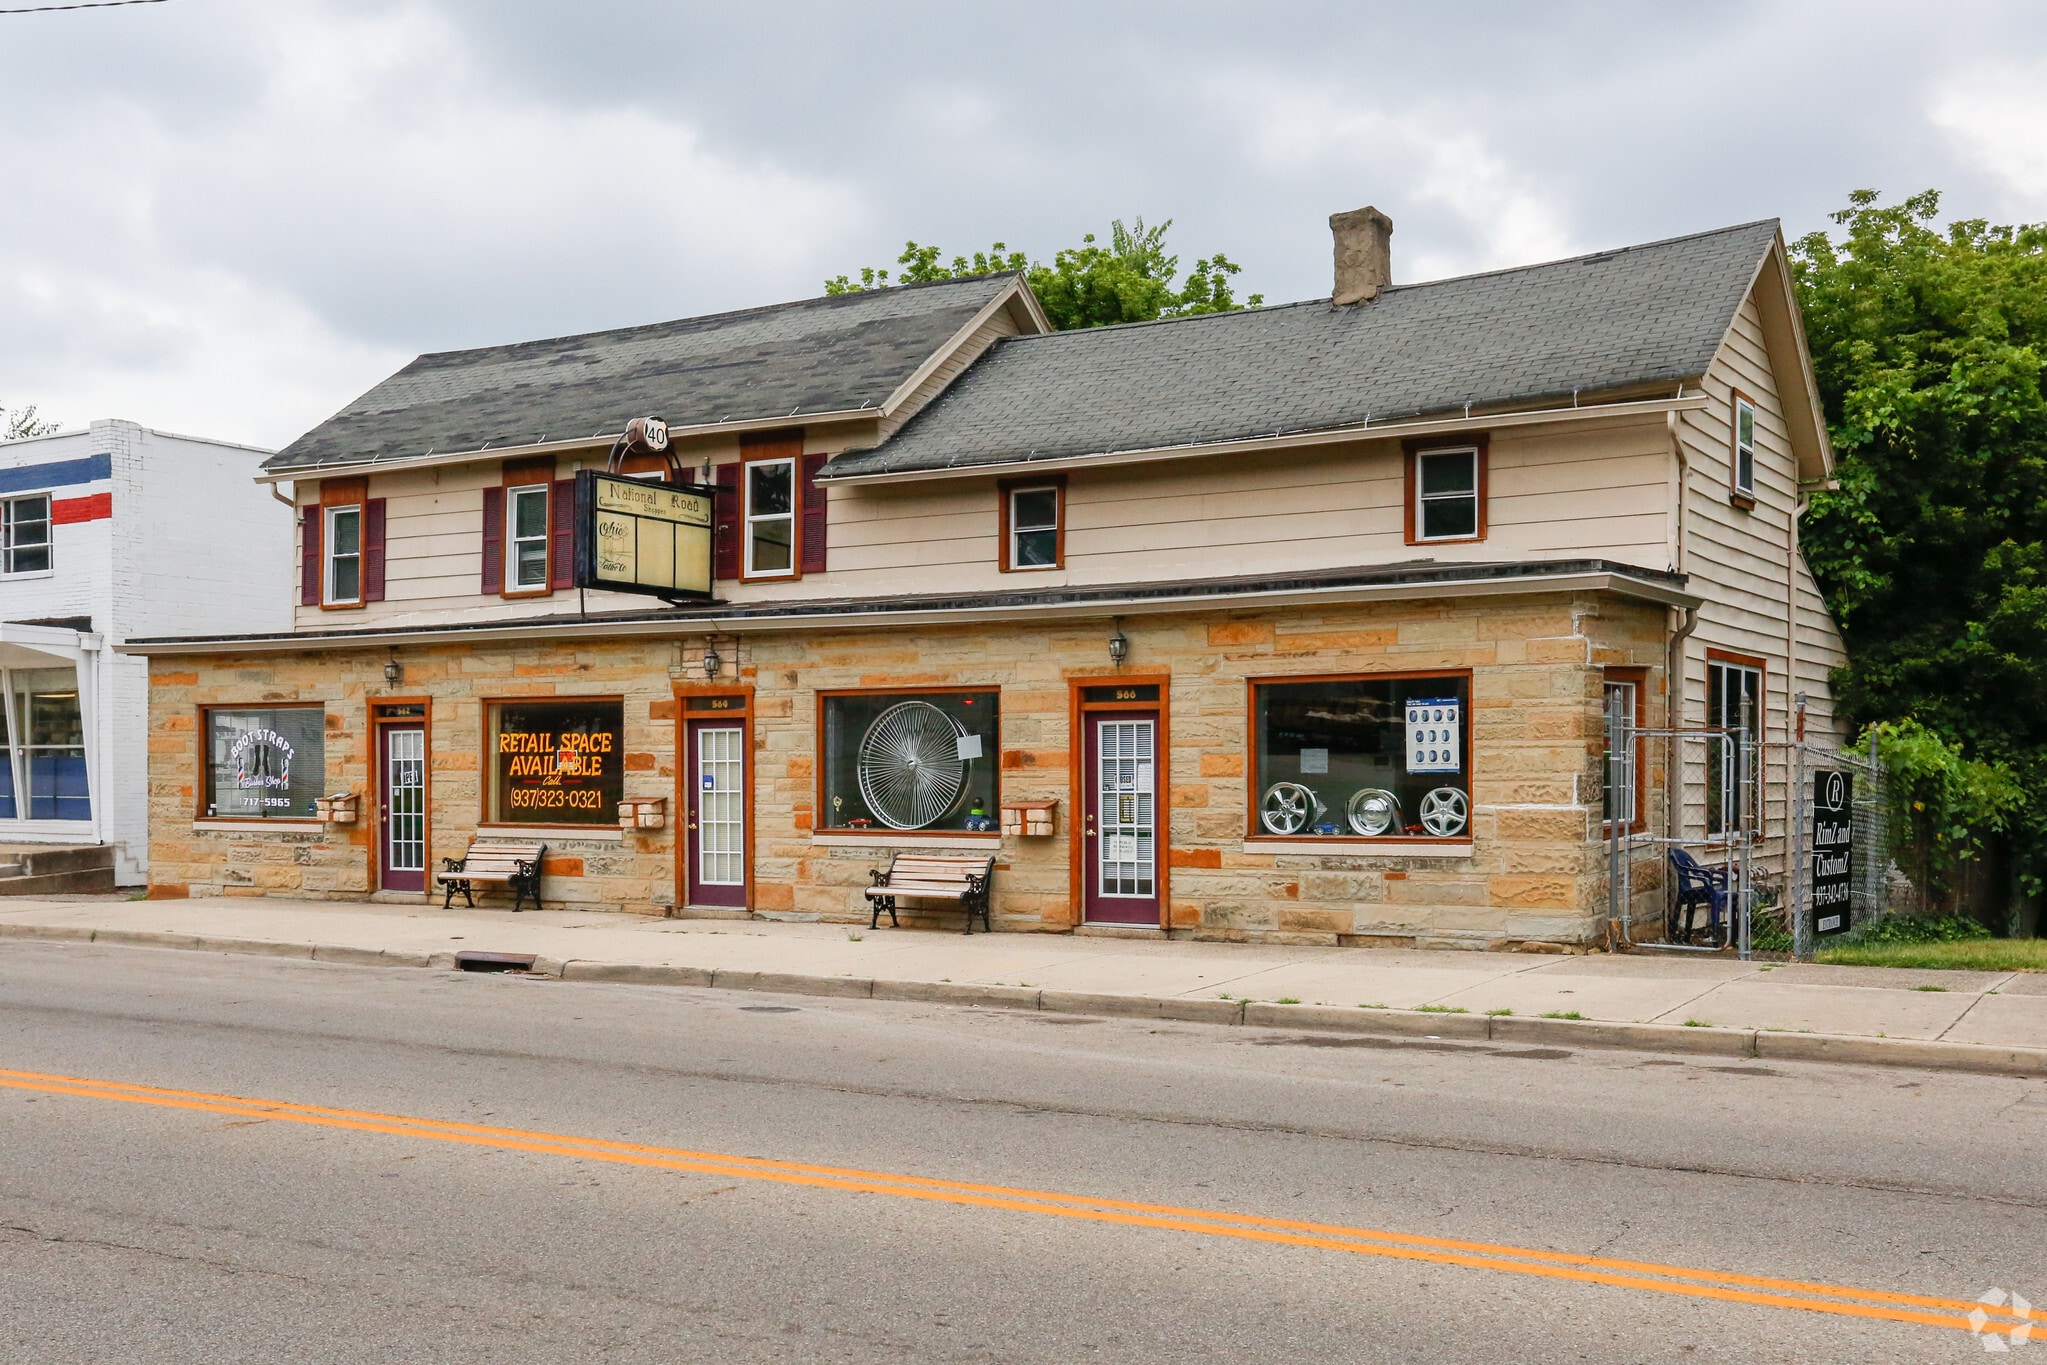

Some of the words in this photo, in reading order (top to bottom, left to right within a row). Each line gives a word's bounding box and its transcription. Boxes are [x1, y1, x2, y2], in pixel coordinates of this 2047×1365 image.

[647, 426, 665, 445] 40
[609, 483, 657, 505] National
[671, 494, 700, 513] Road
[1116, 690, 1136, 699] 566
[231, 731, 254, 758] BOOT
[257, 729, 295, 760] STRAPS
[499, 733, 555, 753] RETAIL
[560, 733, 613, 753] SPACE
[509, 755, 602, 776] AVAILABLE
[265, 775, 281, 789] Shop
[1831, 780, 1840, 802] R
[1815, 821, 1838, 846] RimZ
[1837, 820, 1851, 844] and
[1816, 851, 1849, 878] CustomZ
